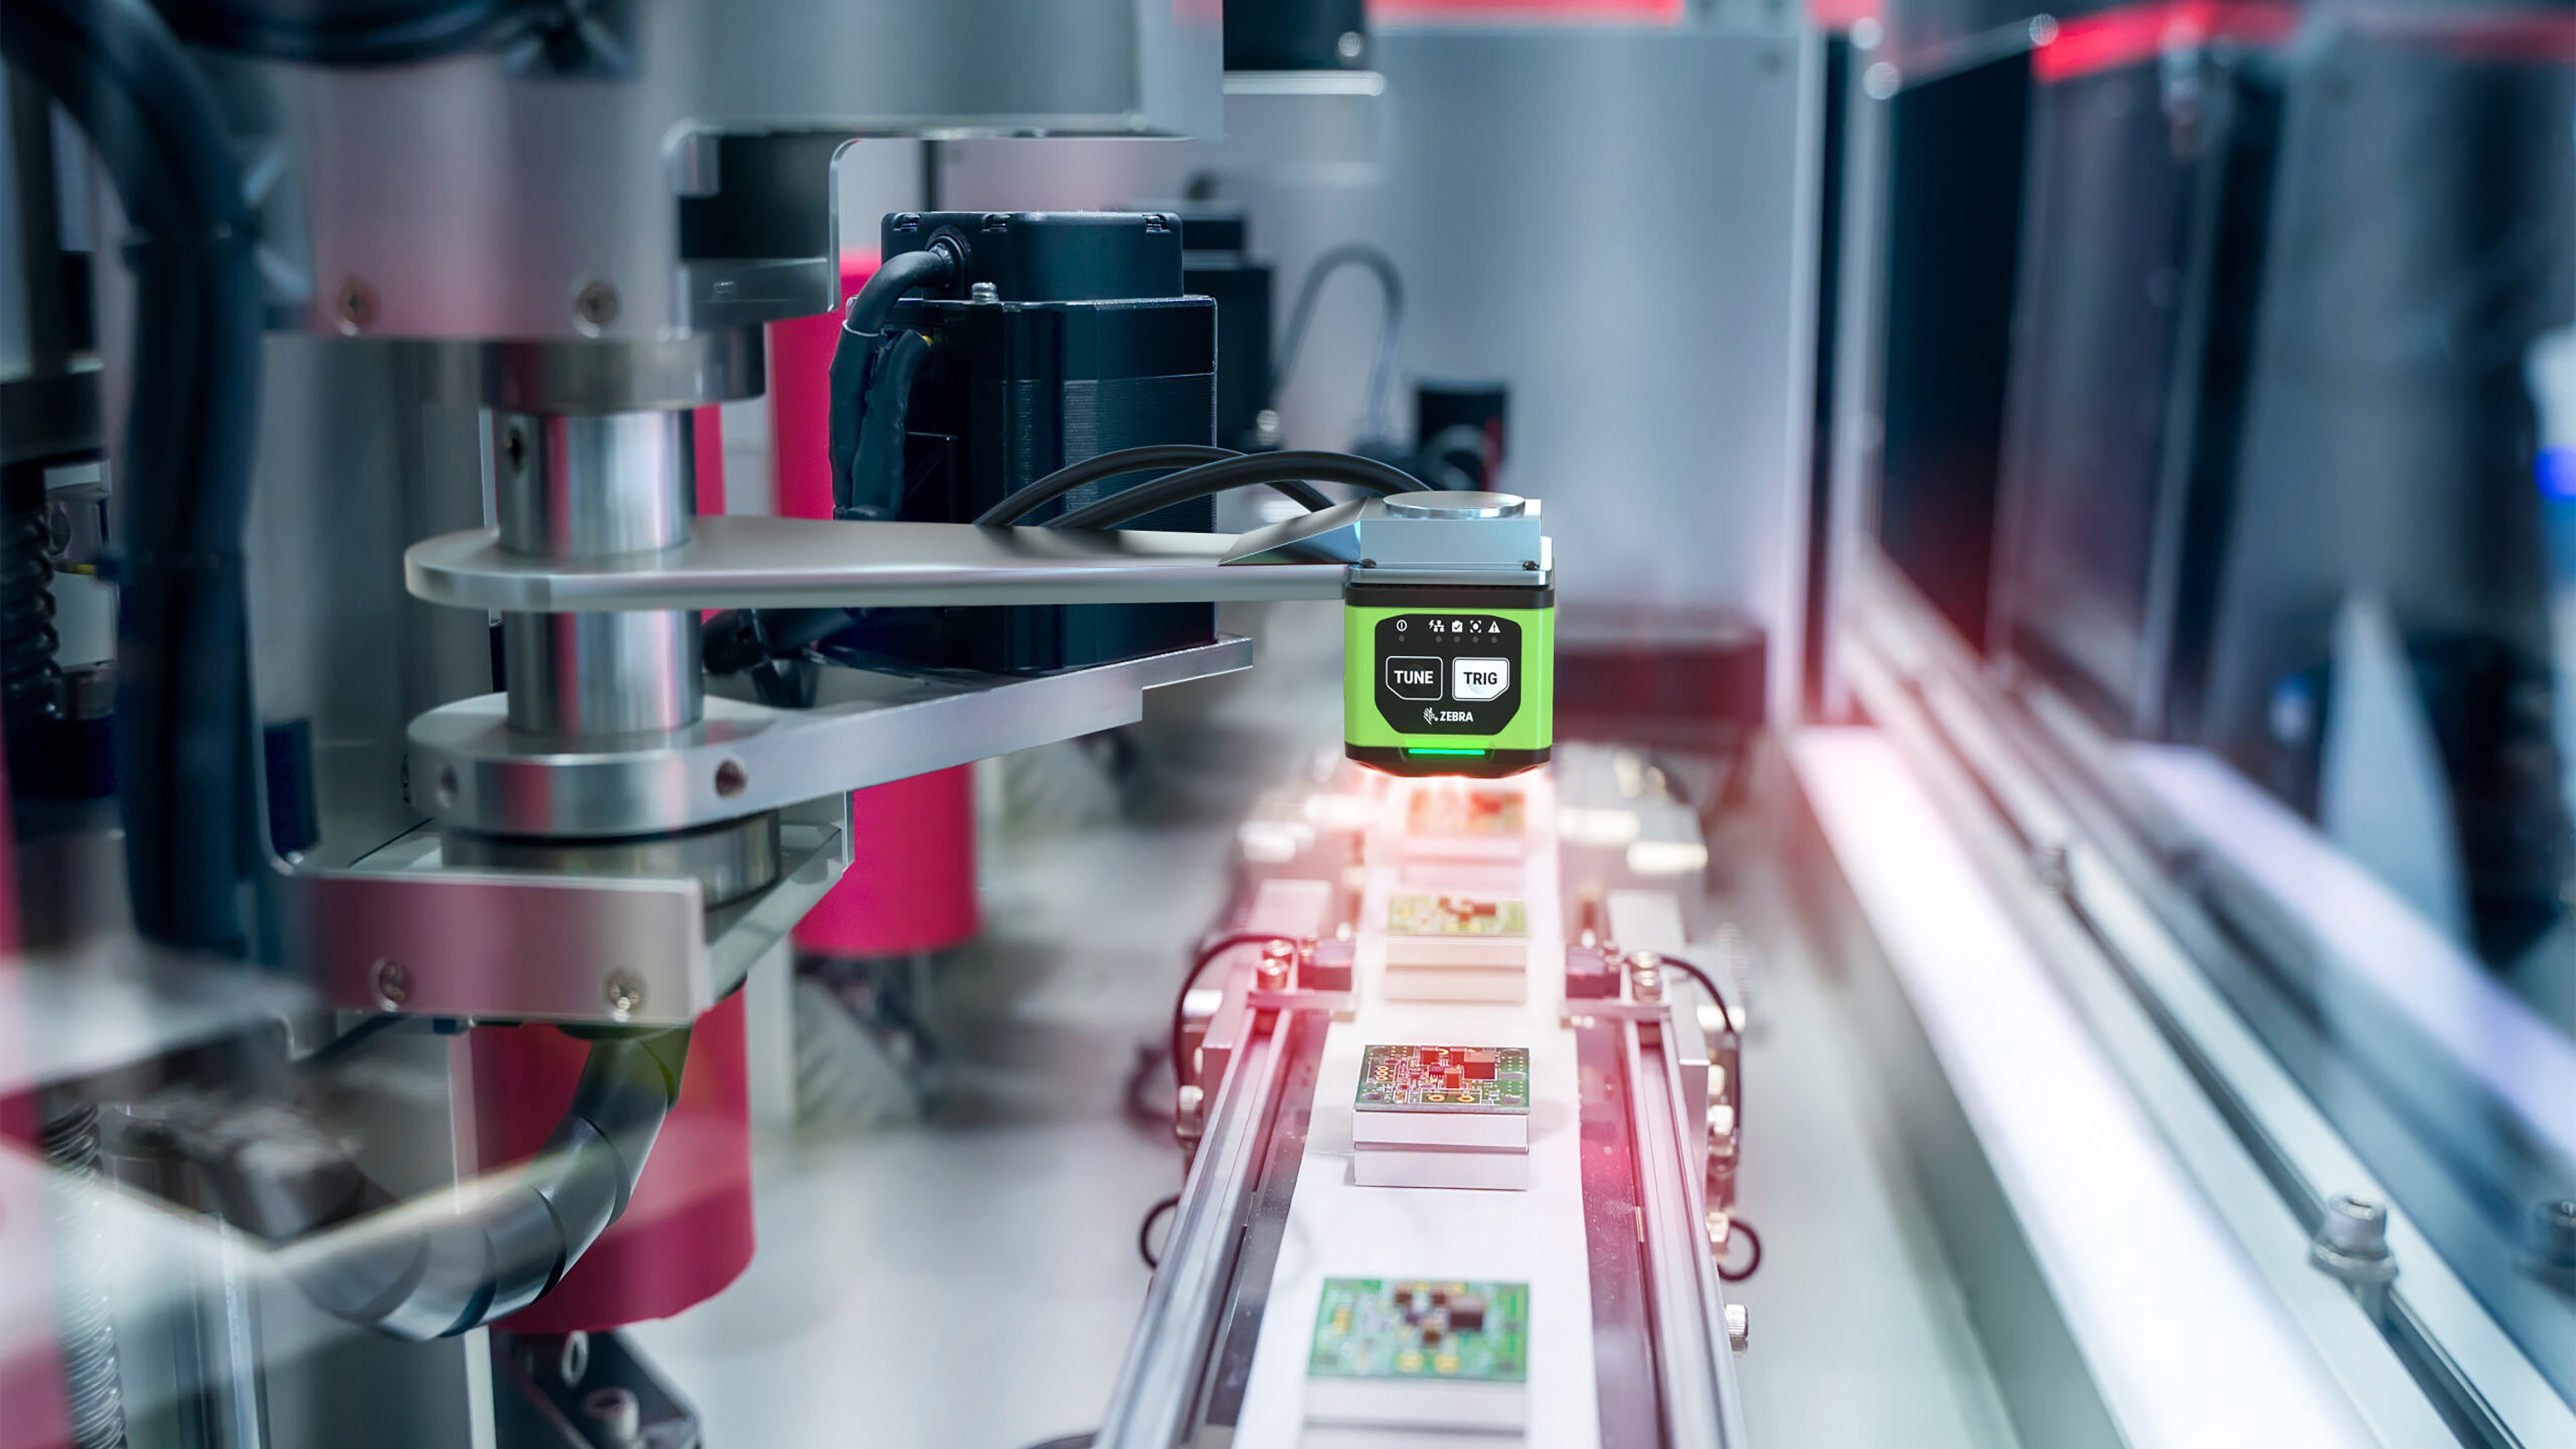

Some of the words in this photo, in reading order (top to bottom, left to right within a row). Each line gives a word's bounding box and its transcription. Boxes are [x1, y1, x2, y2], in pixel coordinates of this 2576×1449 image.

[1394, 670, 1433, 685] TUNE
[1463, 671, 1498, 686] TRIG
[1440, 711, 1473, 722] ZEBRA
